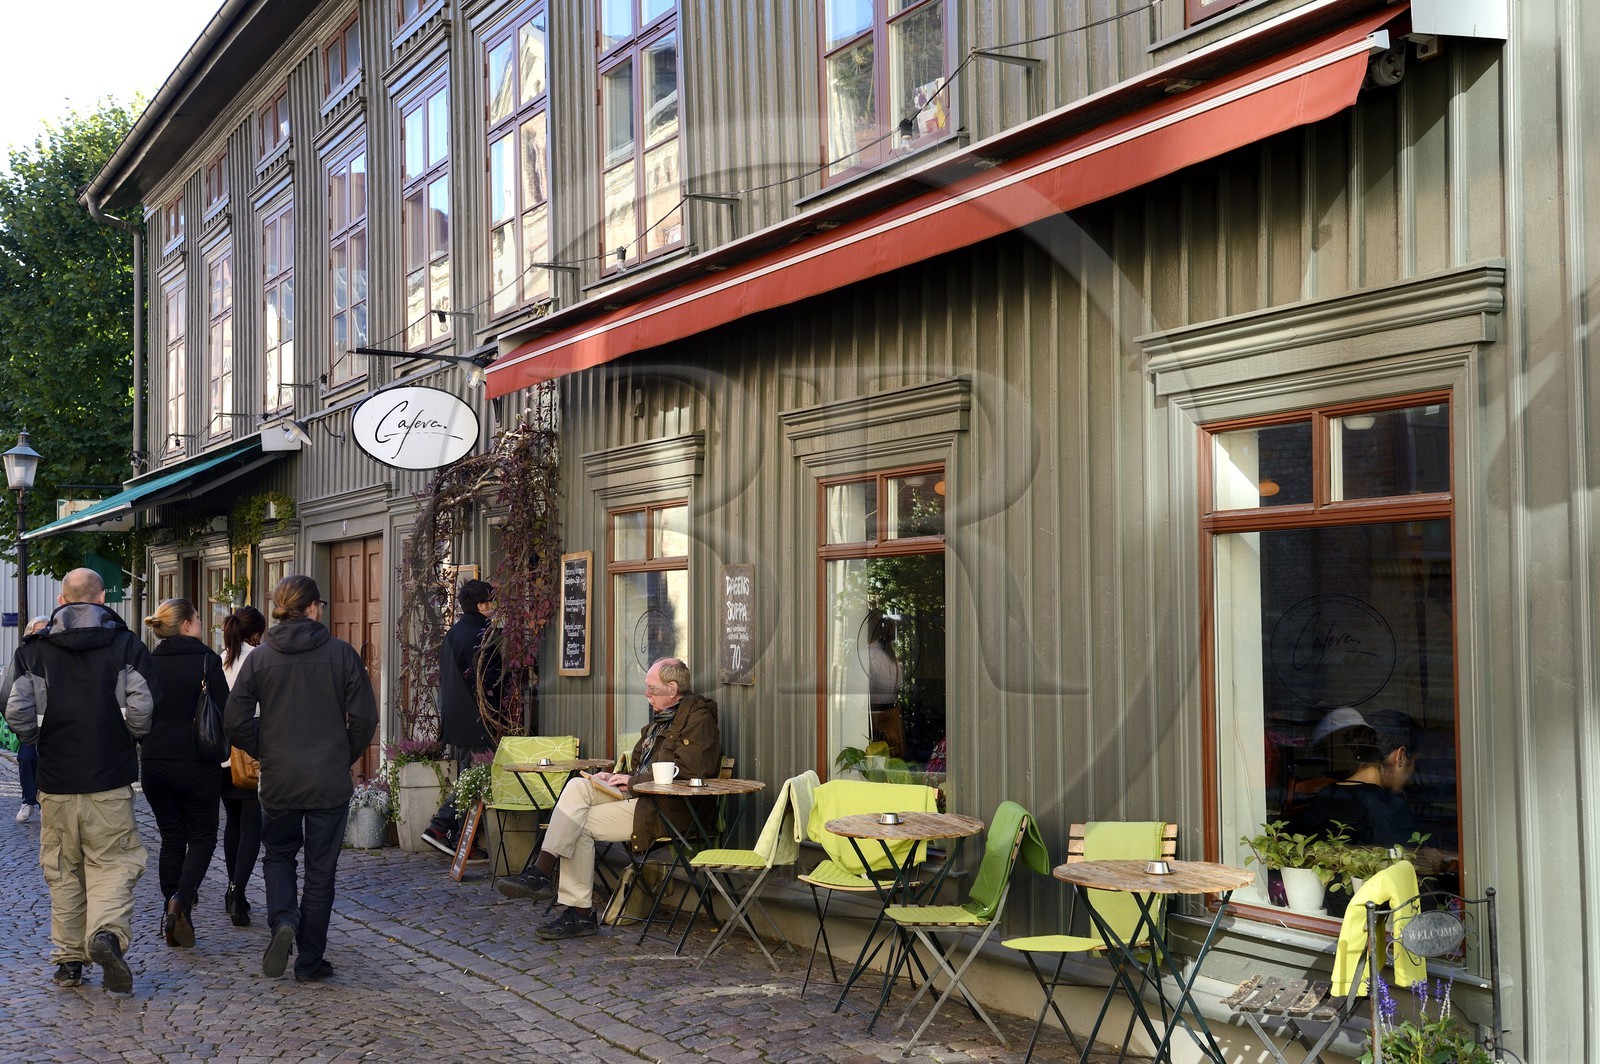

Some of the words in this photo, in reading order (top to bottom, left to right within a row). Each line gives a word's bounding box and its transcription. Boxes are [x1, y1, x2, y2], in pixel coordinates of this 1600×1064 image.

[725, 575, 750, 596] DAGENS
[726, 600, 748, 622] SOPPA
[1408, 926, 1459, 941] WELCOME
